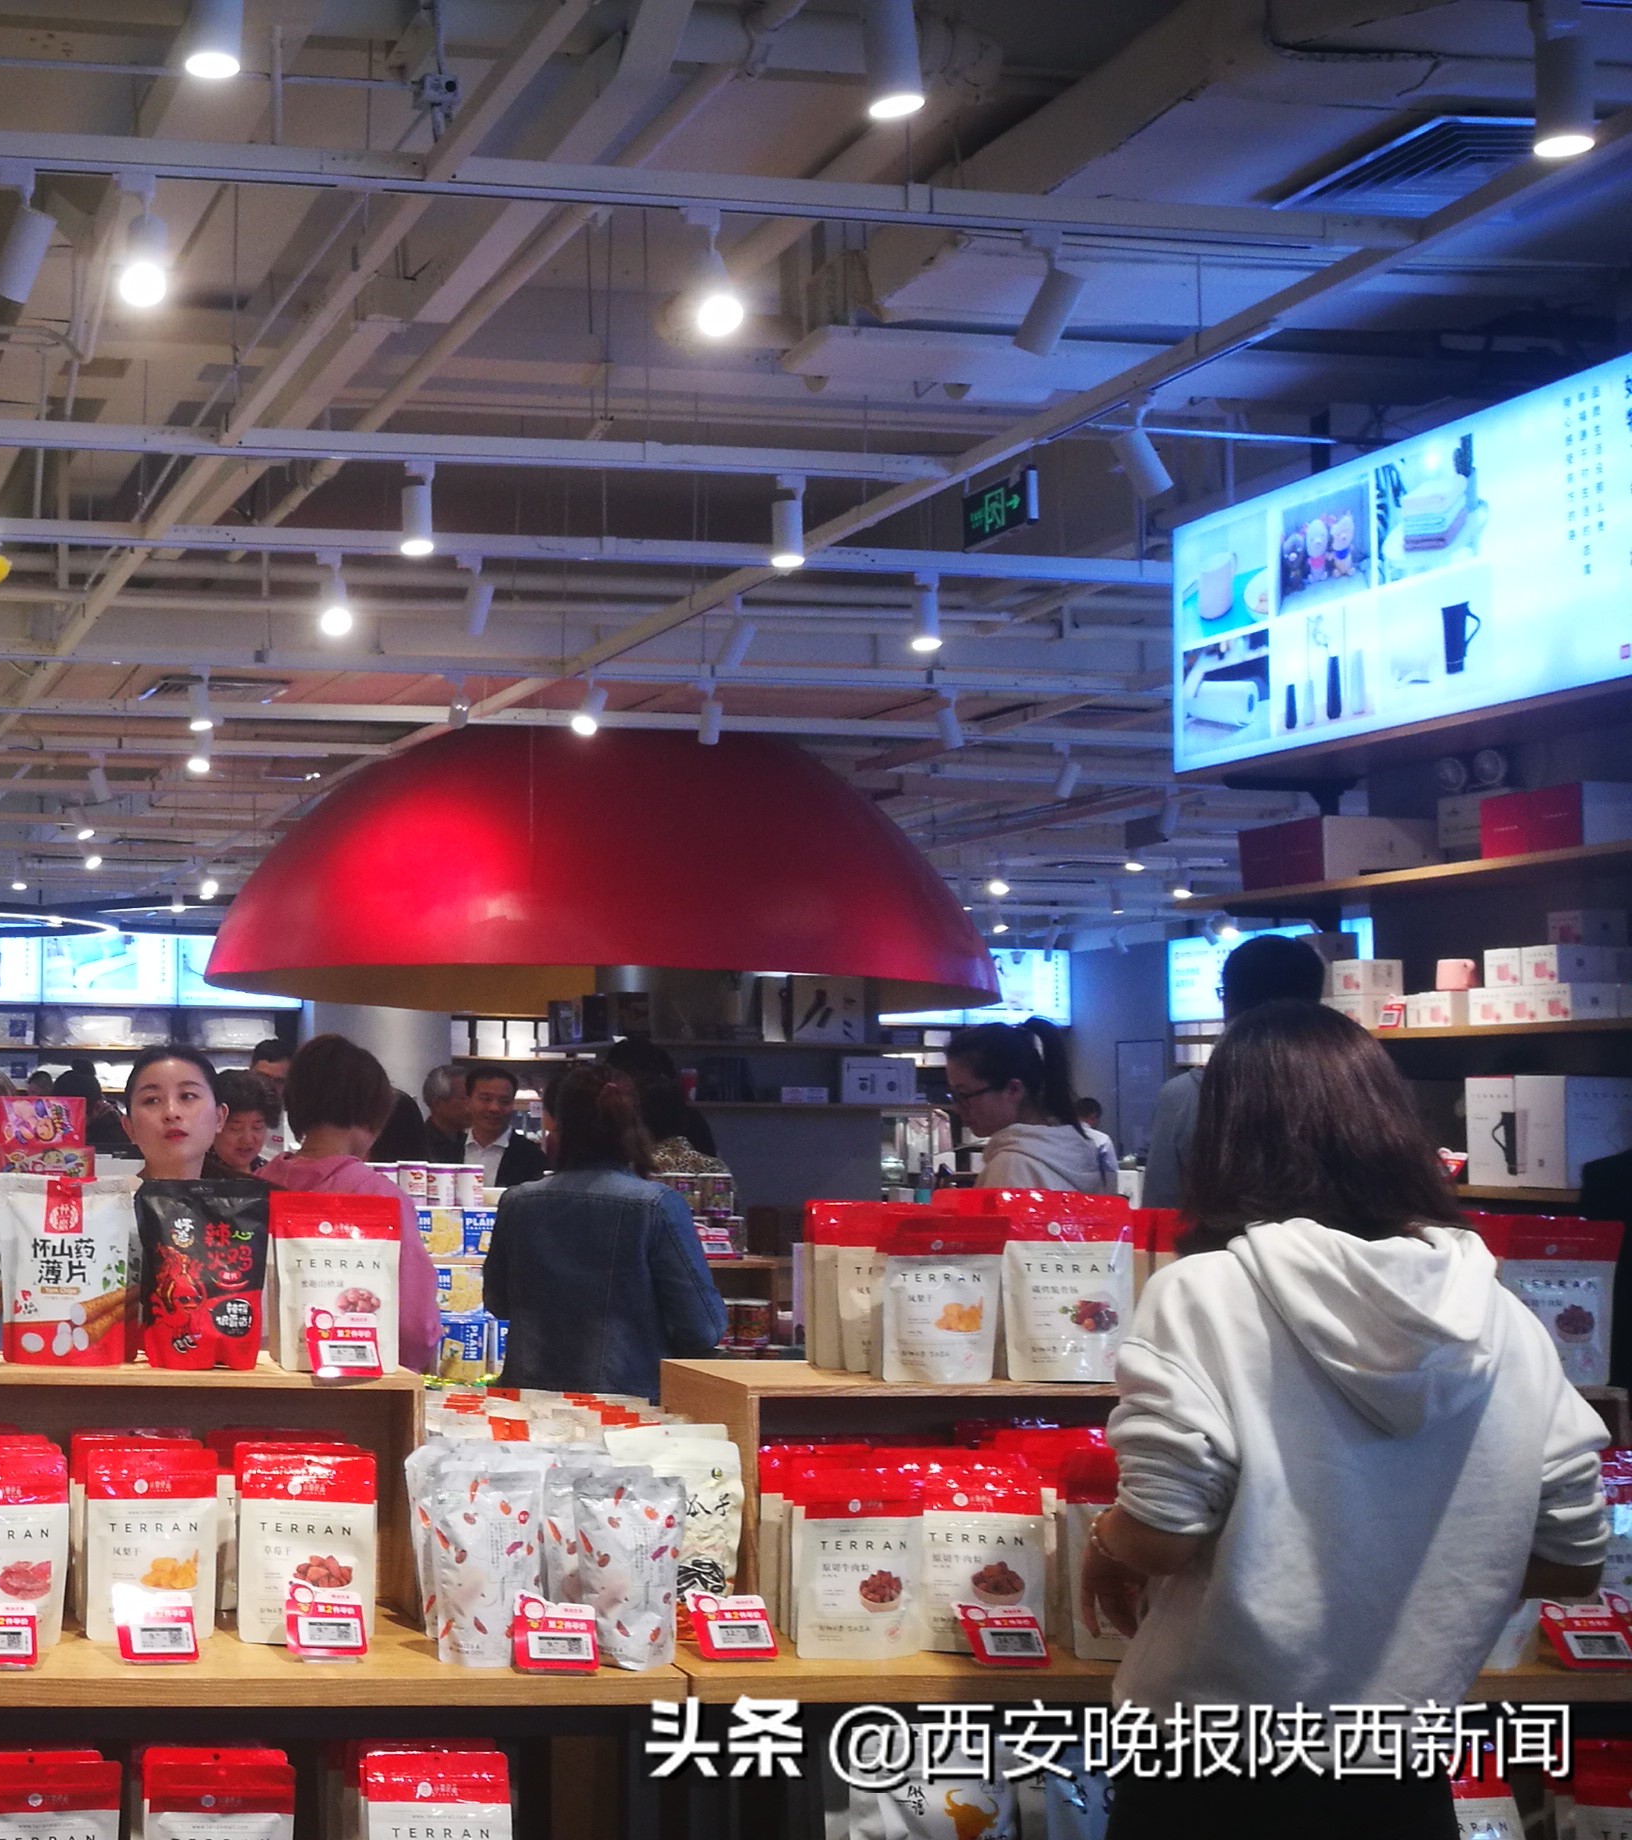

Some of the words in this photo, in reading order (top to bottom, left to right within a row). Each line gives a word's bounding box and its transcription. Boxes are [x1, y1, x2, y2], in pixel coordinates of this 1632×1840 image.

[32, 1238, 95, 1259] 怀山药
[296, 1259, 382, 1269] TERRAN
[1025, 1262, 1116, 1273] TERRAN
[37, 1260, 87, 1285] 薄片
[899, 1273, 982, 1282] TERRAN
[109, 1522, 199, 1532] TERRAN
[260, 1522, 352, 1536] TERRAN
[929, 1532, 1025, 1546] TERRAN
[820, 1541, 907, 1550] TERRAN
[548, 1620, 588, 1631] 第2件半价
[392, 1827, 490, 1838] TERRAN
